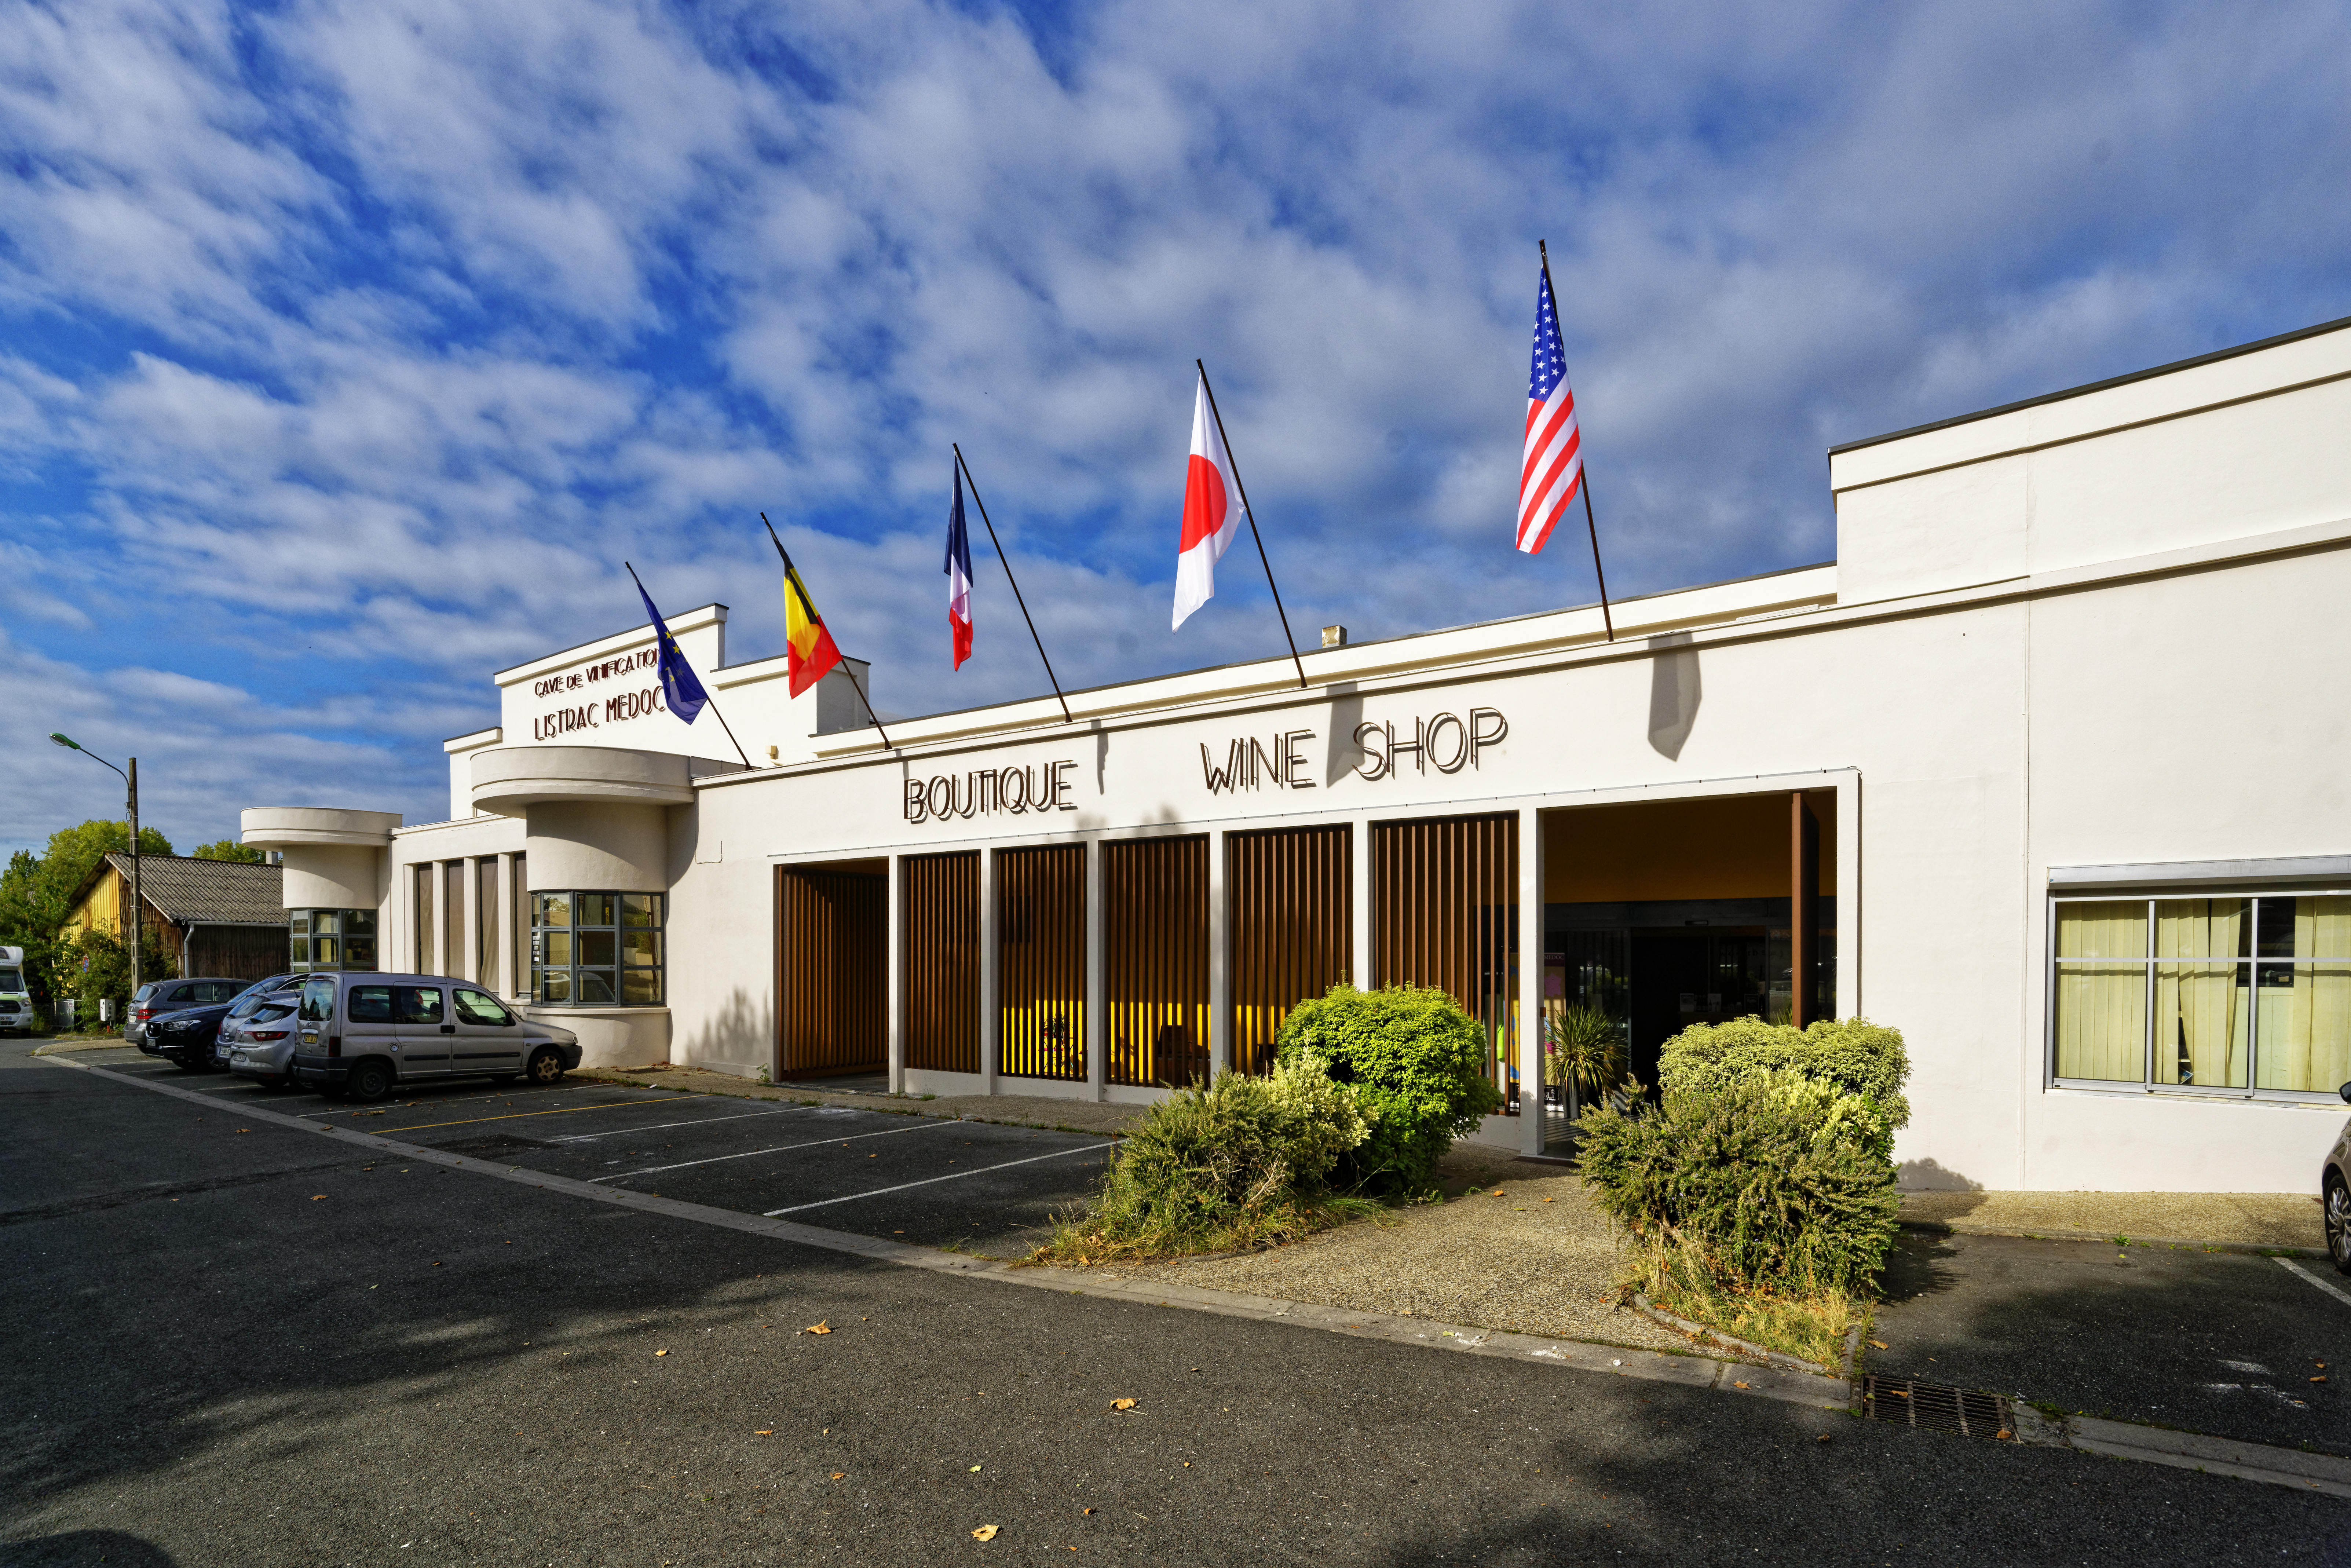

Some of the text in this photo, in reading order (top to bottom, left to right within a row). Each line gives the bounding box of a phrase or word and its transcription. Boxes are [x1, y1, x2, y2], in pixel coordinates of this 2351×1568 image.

[535, 676, 564, 696] CAVE
[566, 673, 583, 688] DE
[535, 686, 665, 739] LISTRAC MEDOC
[1200, 707, 1504, 790] WINE SHOP
[904, 760, 1074, 819] BOUTIQUE
